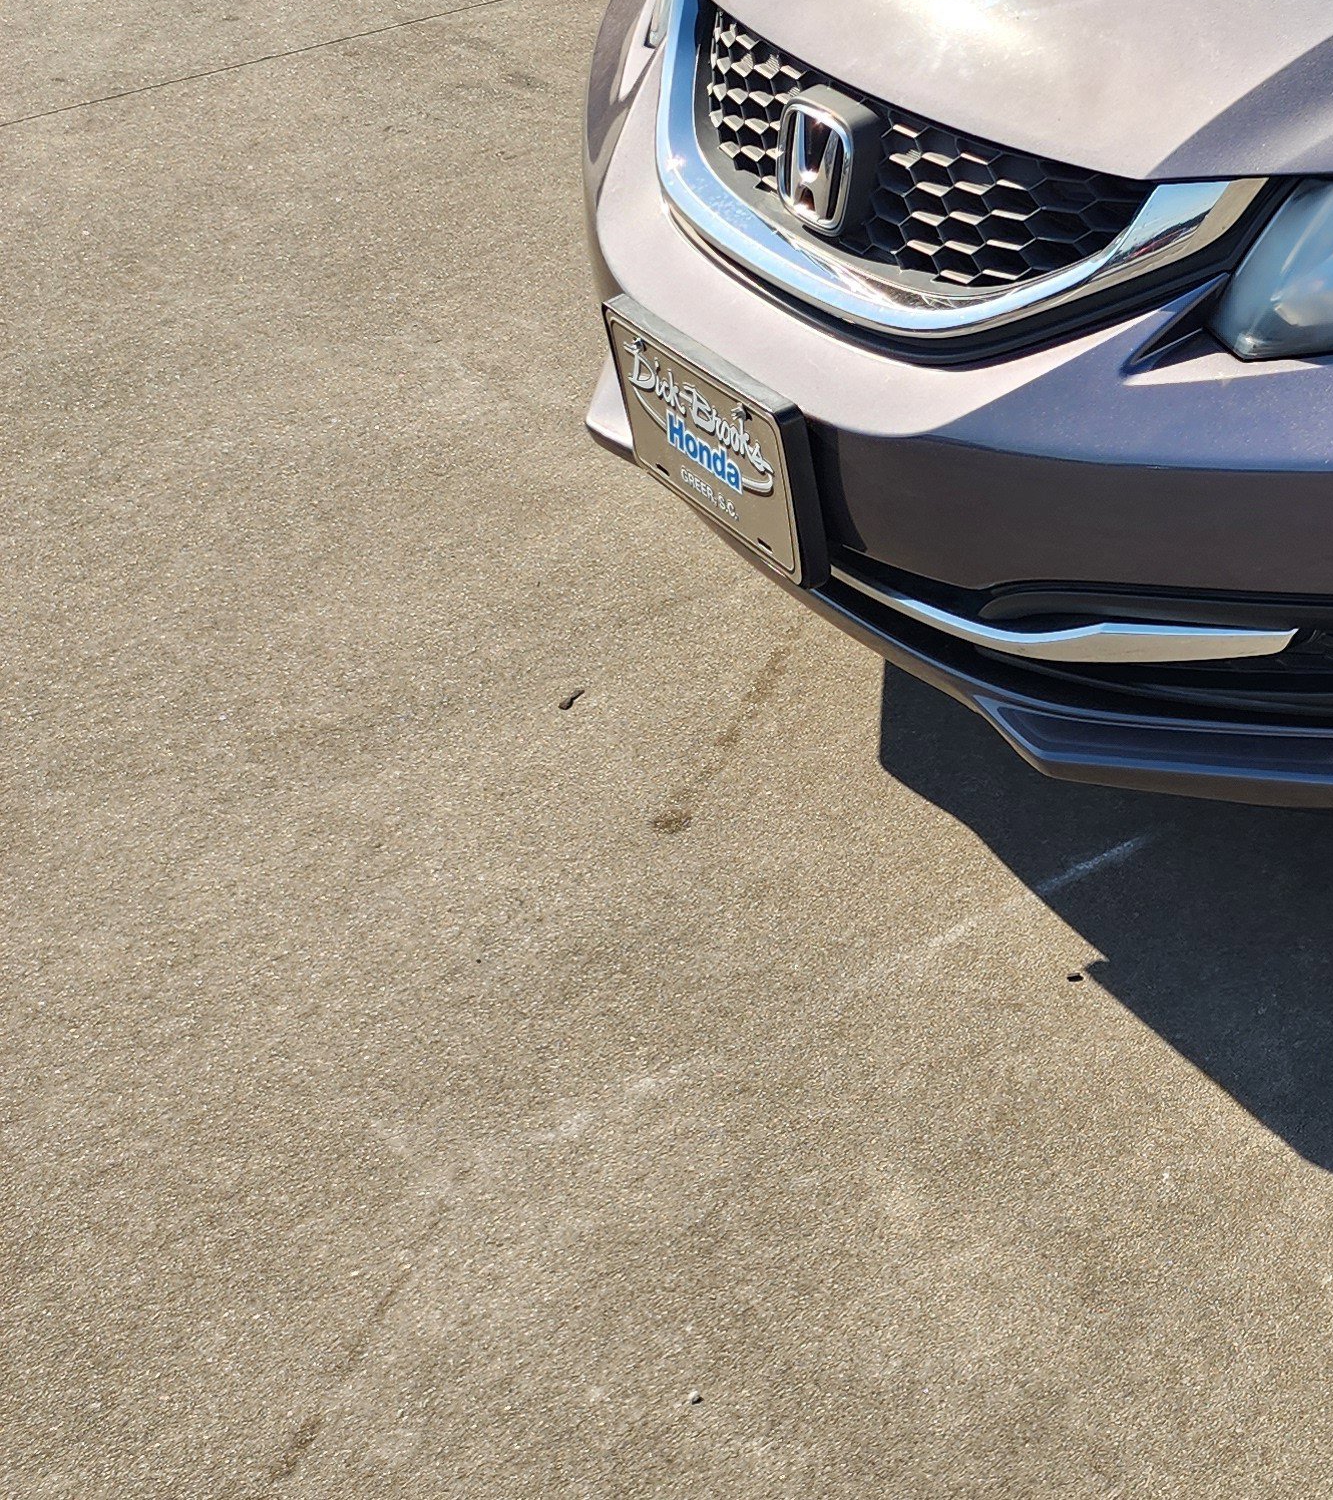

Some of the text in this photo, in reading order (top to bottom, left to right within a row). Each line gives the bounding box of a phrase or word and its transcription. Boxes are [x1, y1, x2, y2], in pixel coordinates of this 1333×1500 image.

[623, 337, 774, 474] Dick Brooks
[666, 409, 743, 495] Honda
